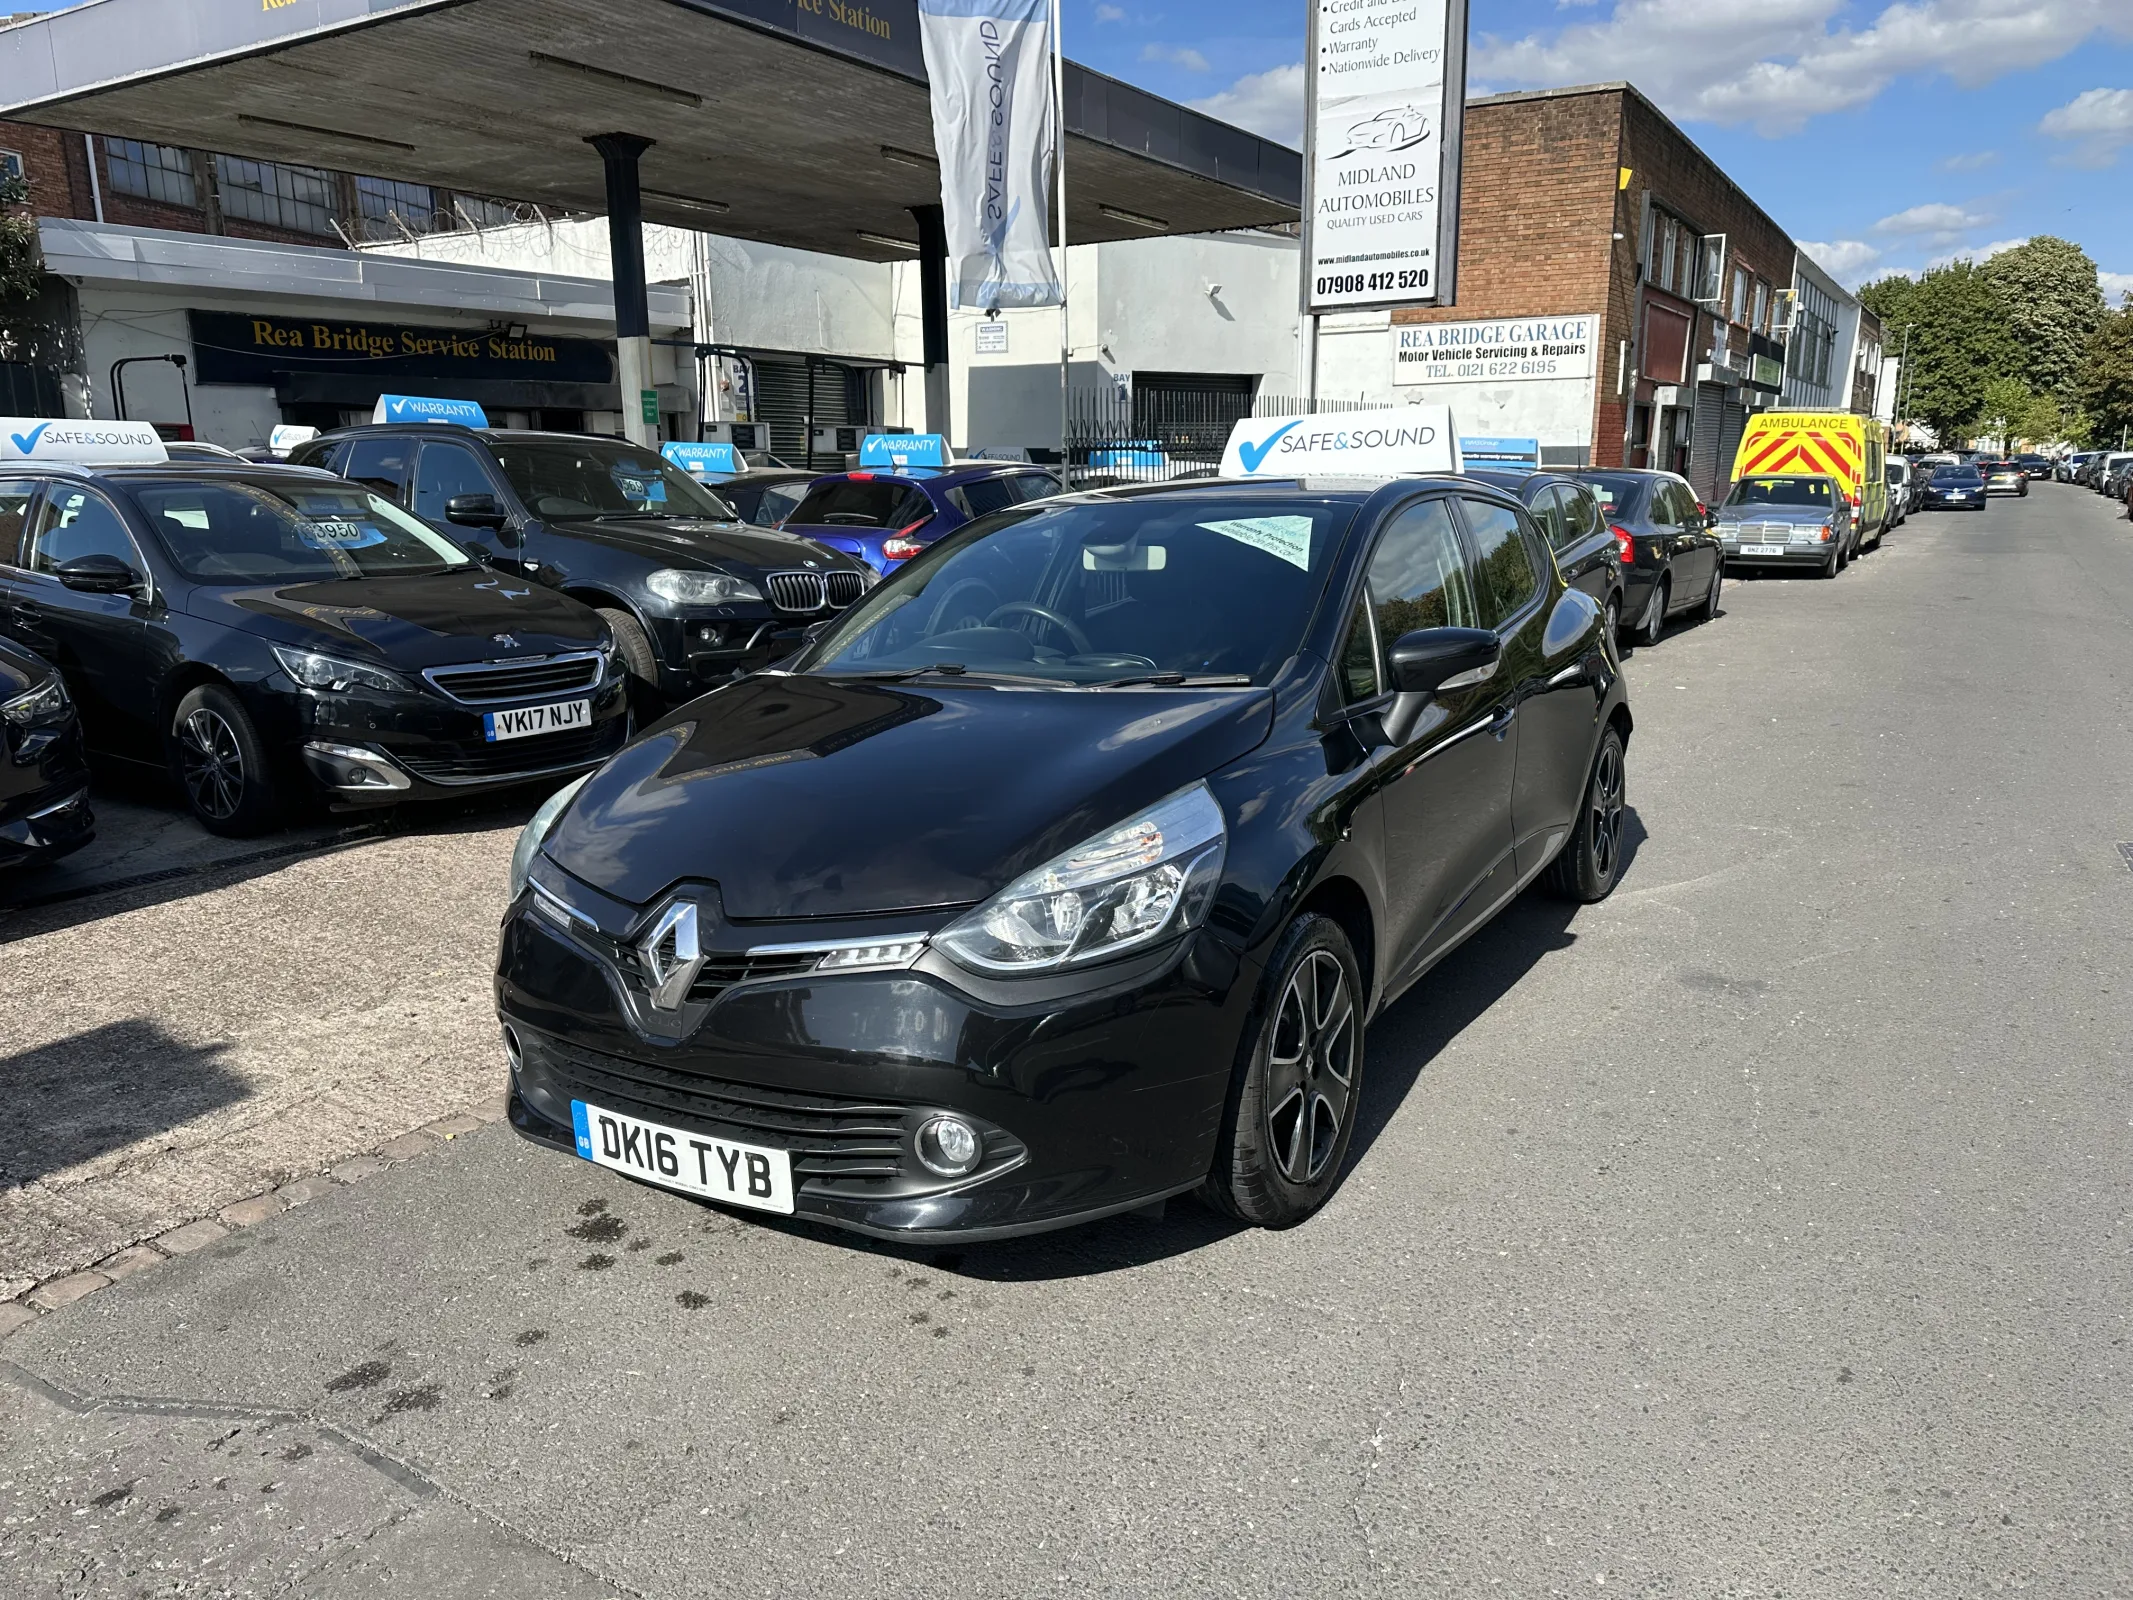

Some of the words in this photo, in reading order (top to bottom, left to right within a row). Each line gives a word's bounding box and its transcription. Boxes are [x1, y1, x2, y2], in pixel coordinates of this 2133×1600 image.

[1330, 0, 1363, 13] Credit
[829, 0, 891, 39] Station
[1330, 18, 1360, 34] Cards
[1364, 7, 1416, 28] Accepted
[1329, 38, 1378, 54] Warranty
[1329, 54, 1390, 74] Nationwide
[1394, 49, 1441, 64] Delivery
[1338, 163, 1416, 187] MIDLAND
[1318, 187, 1434, 213] AUTOMOBILES
[1327, 216, 1367, 230] QUALITY
[1369, 213, 1395, 224] USED
[1397, 211, 1423, 222] CARS
[1318, 248, 1430, 265] www.midlandautomobiles.co.uk
[1317, 274, 1365, 295] 07908
[1368, 271, 1395, 290] 412
[1398, 268, 1429, 289] 520
[252, 320, 304, 347] Rea
[312, 325, 394, 358] Bridge
[401, 331, 479, 358] Service
[489, 338, 556, 361] Station
[1400, 330, 1434, 348] REA
[1438, 326, 1505, 346] BRIDGE
[1509, 321, 1587, 342] GARAGE
[1399, 350, 1429, 363] Motor
[1432, 347, 1472, 361] Vehicle
[1475, 345, 1527, 360] Servicing
[1530, 345, 1539, 356] &
[1542, 343, 1586, 356] Repairs
[1113, 373, 1130, 382] BAY
[1426, 365, 1454, 378] TEL.
[1457, 363, 1485, 376] 0121
[1489, 362, 1517, 375] 622
[1521, 360, 1557, 374] 6195
[408, 401, 476, 416] WARRANTY
[1760, 418, 1848, 428] AMBULANCE
[44, 431, 153, 445] SAFE&SOUND
[881, 439, 936, 451] WARRANTY
[1280, 427, 1435, 454] SAFE&SOUND
[679, 447, 728, 459] WARRANTY
[1230, 521, 1263, 535] Warranty
[1264, 533, 1304, 552] Protection
[502, 708, 544, 734] VK17
[550, 702, 583, 727] NJY
[579, 1135, 590, 1149] GB
[599, 1115, 679, 1177] DK16
[690, 1139, 772, 1199] TYB
